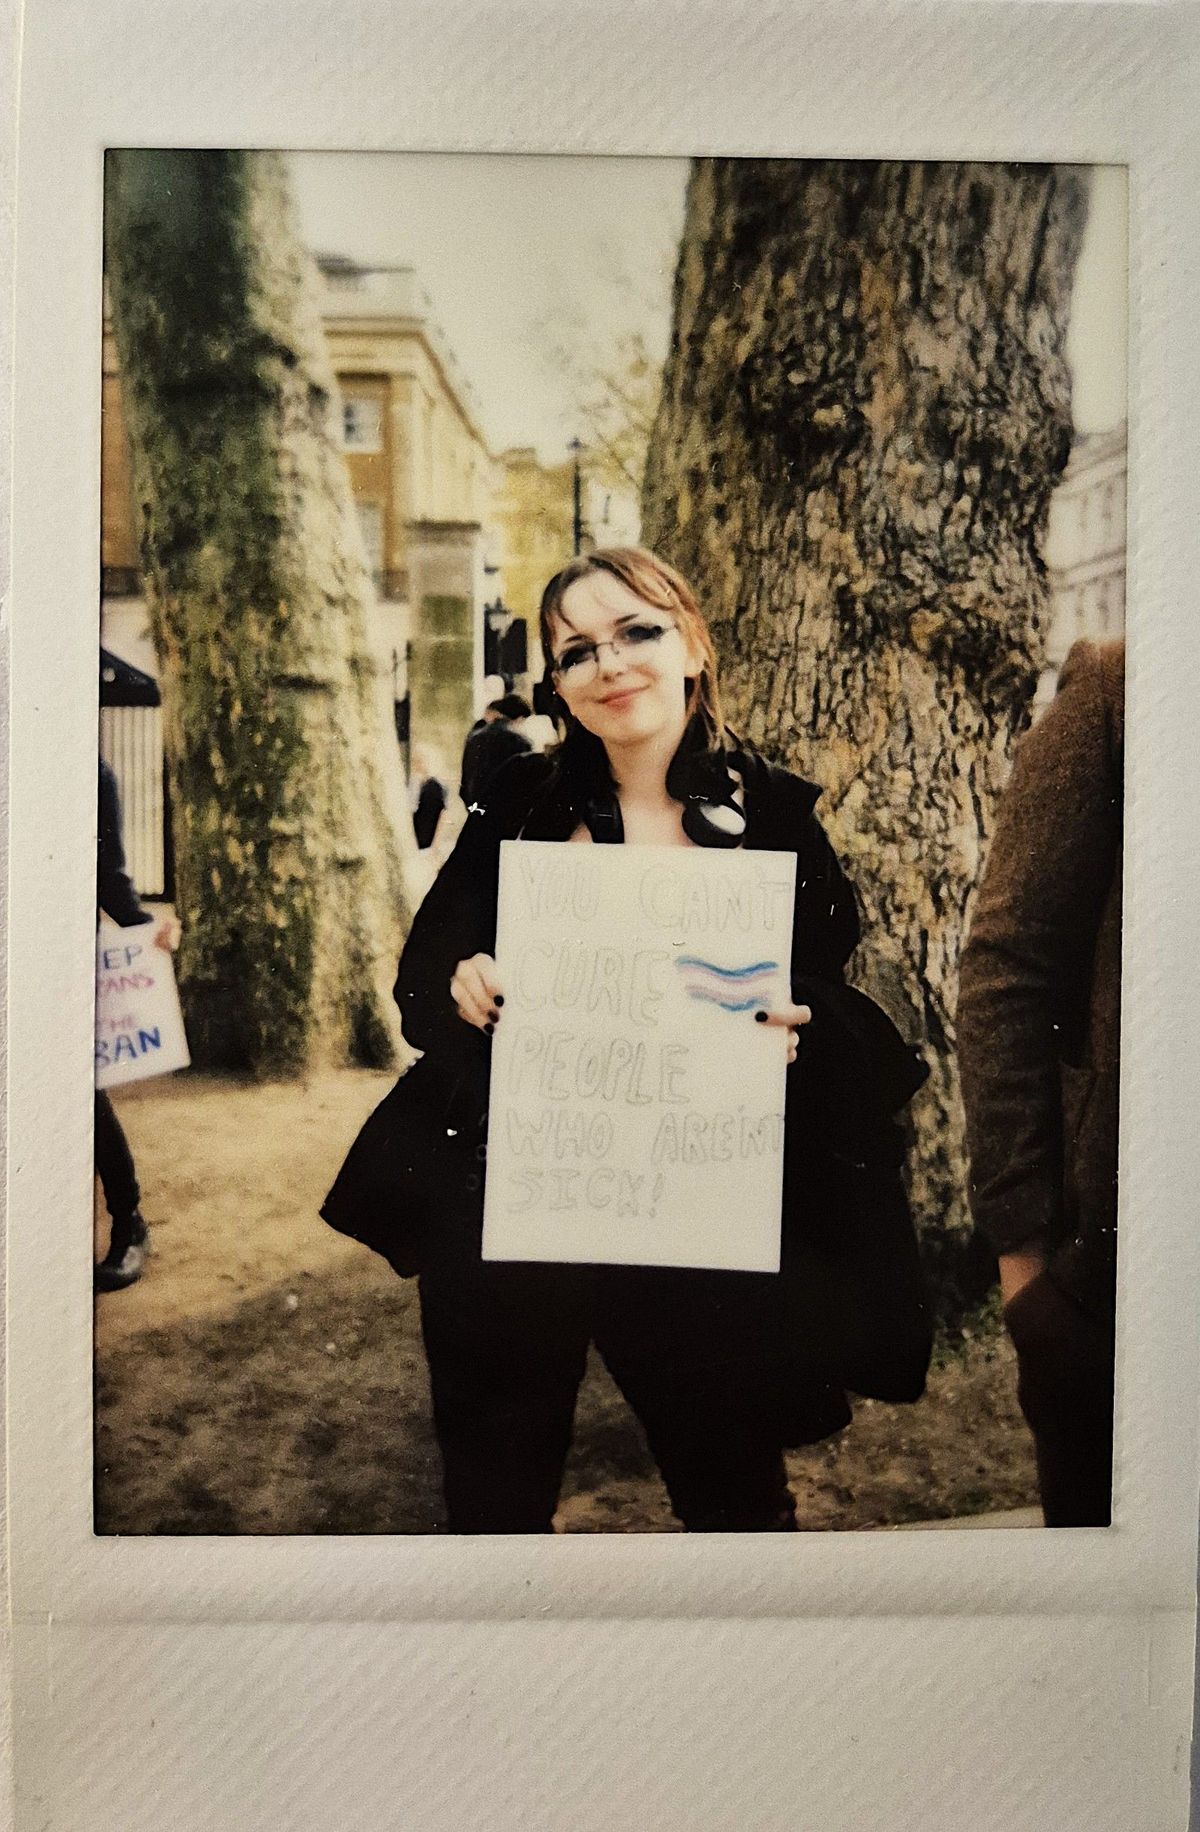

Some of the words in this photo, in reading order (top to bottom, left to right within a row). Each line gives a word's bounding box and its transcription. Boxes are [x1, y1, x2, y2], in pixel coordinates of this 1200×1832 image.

[518, 854, 601, 922] YOU
[512, 938, 670, 1027] CURE
[507, 1025, 692, 1105] PEOPLE
[506, 1107, 615, 1160] WHO
[506, 1166, 665, 1219] SICK!
